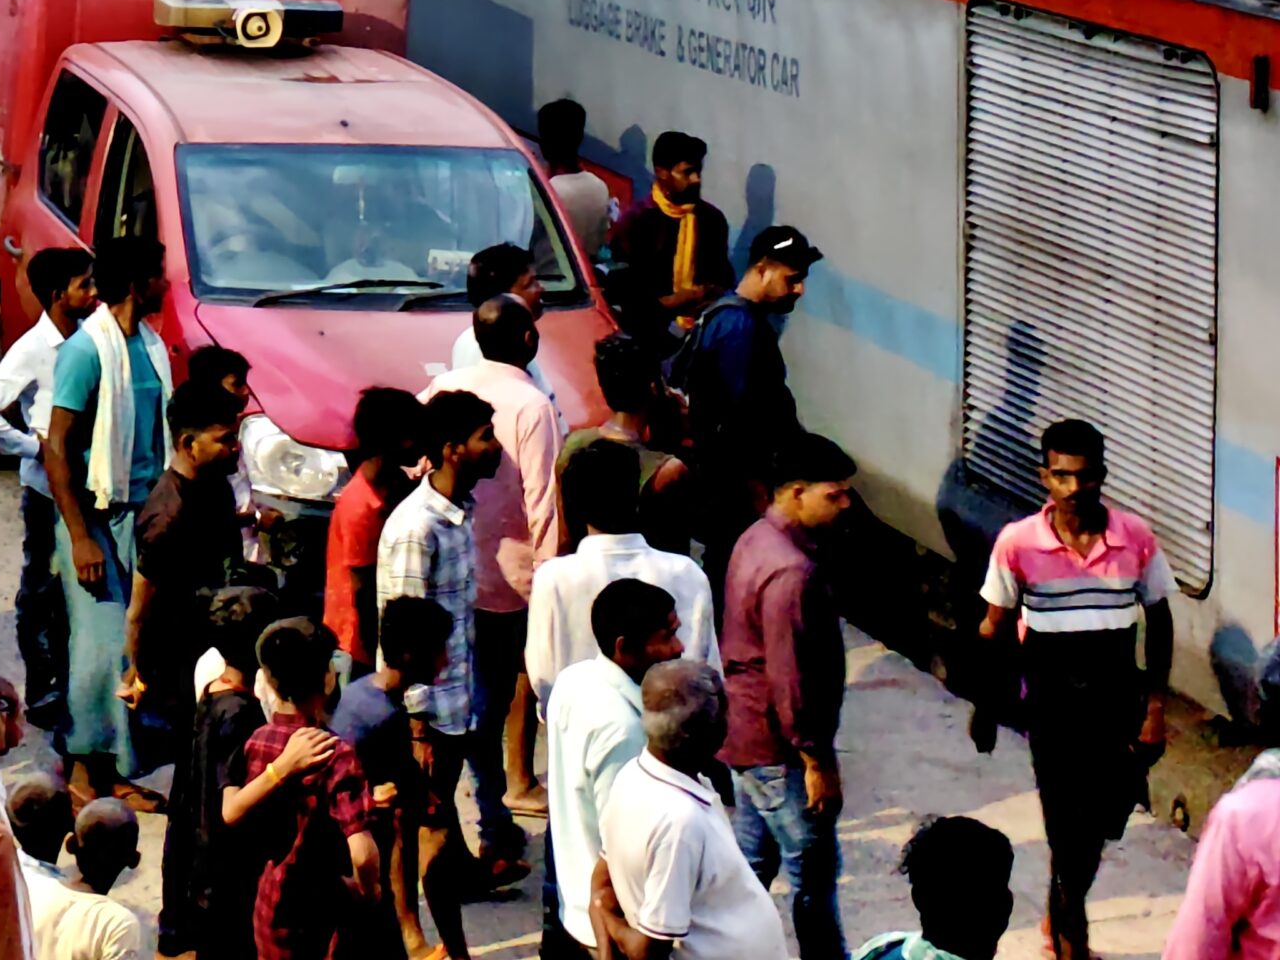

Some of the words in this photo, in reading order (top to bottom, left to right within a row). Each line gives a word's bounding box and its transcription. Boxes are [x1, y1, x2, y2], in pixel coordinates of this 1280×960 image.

[626, 8, 666, 57] BRAKE
[688, 28, 767, 88] GENERATOR
[771, 52, 800, 98] CAR
